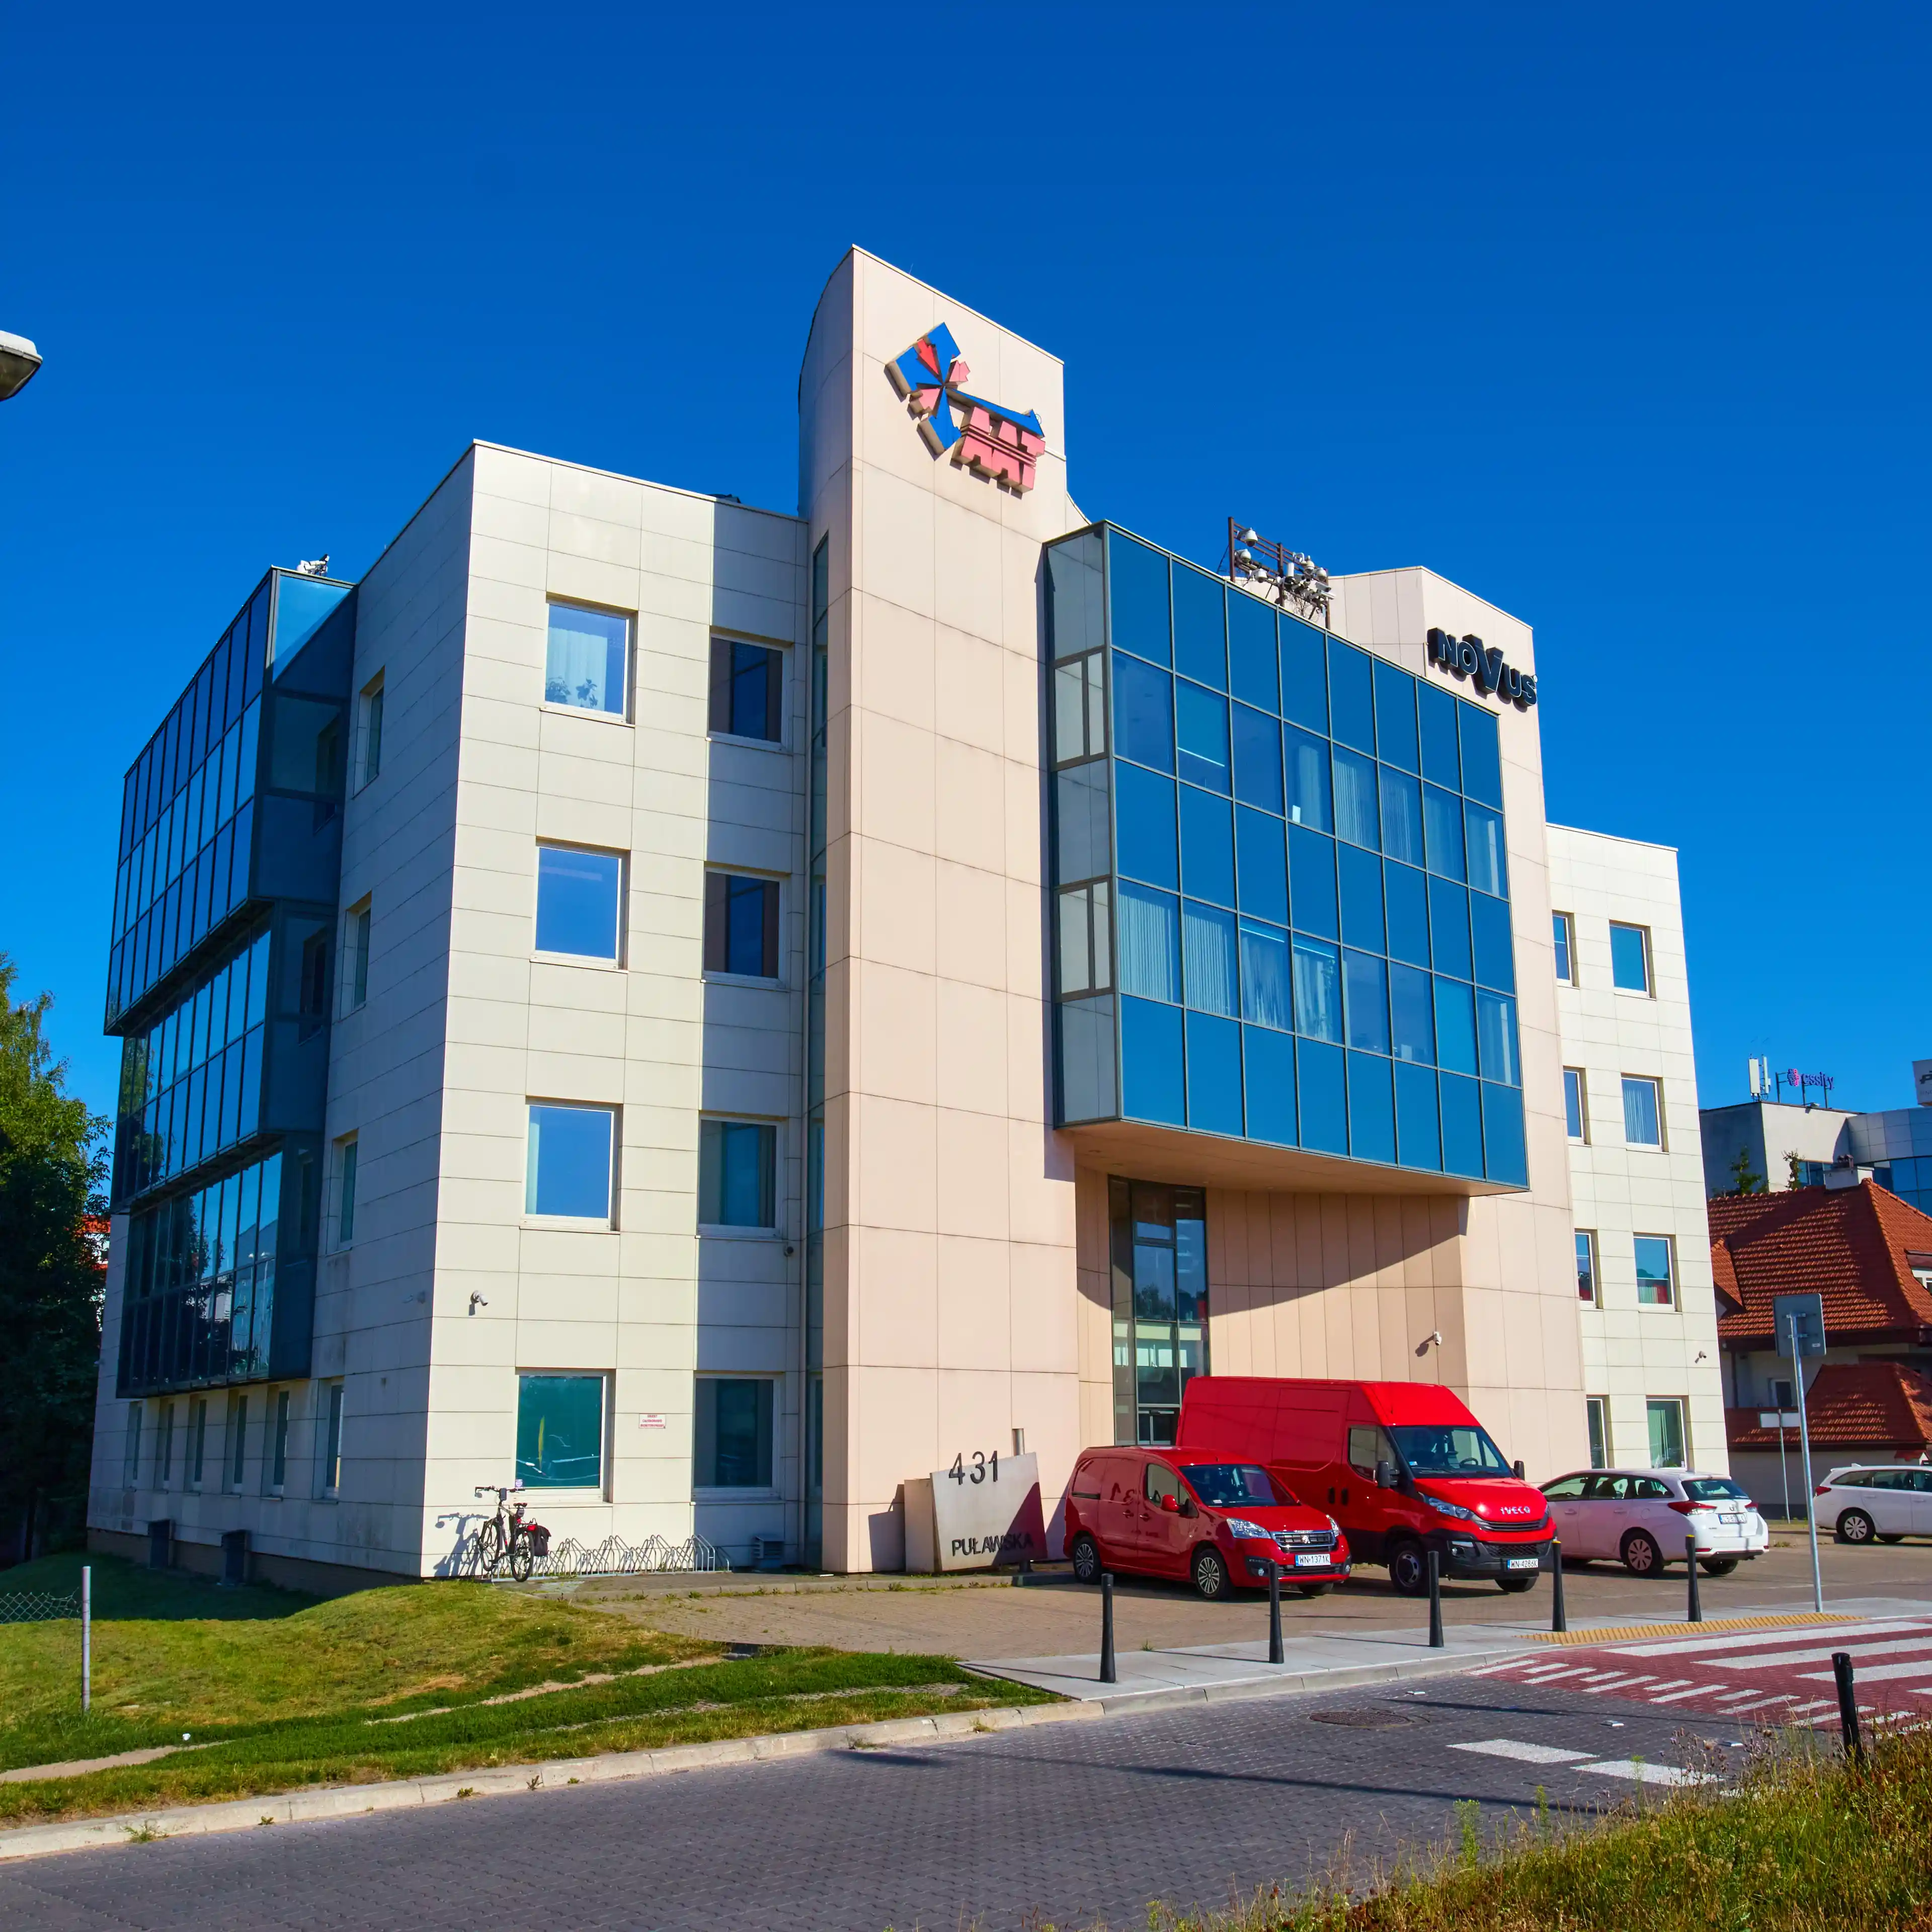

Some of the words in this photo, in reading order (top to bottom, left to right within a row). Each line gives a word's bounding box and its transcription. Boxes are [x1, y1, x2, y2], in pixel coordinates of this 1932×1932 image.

[1427, 627, 1537, 706] NOVUS
[949, 1451, 998, 1485] 431
[1500, 1506, 1531, 1514] IVECO
[952, 1533, 1034, 1556] PUŁAWSKA
